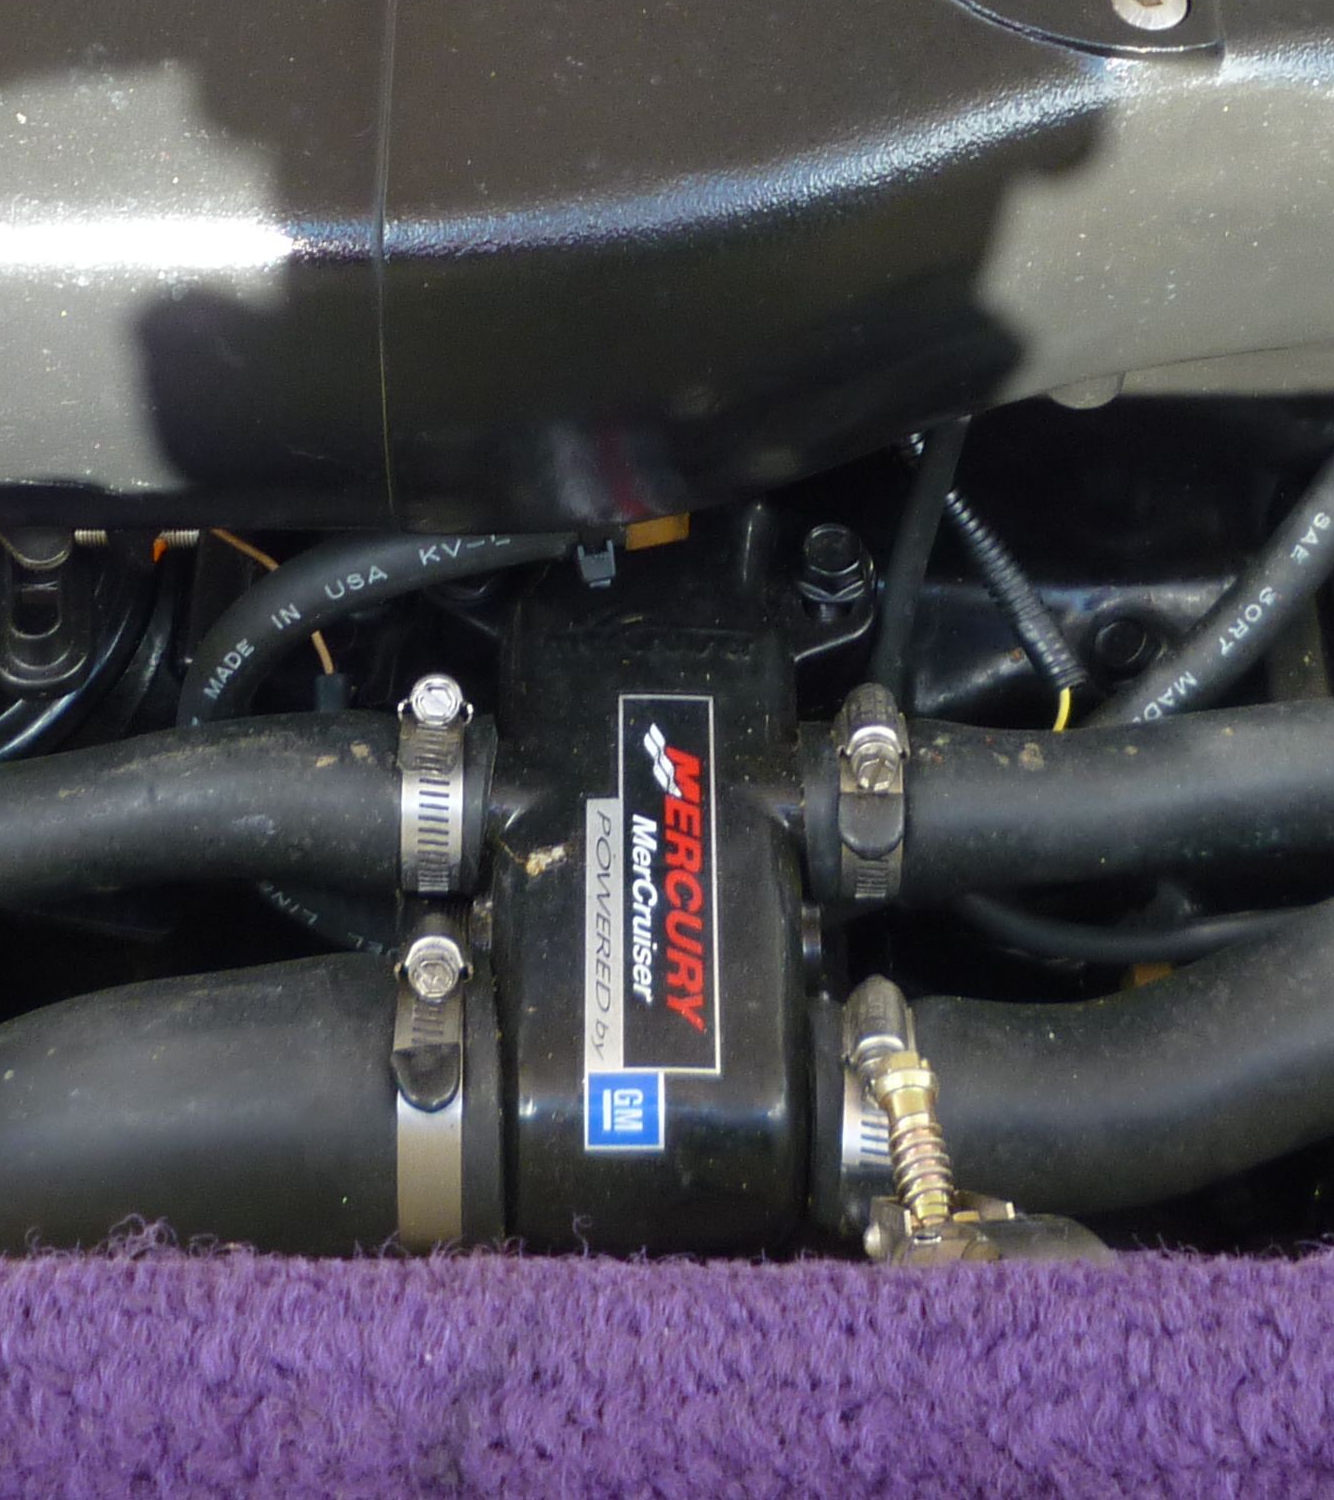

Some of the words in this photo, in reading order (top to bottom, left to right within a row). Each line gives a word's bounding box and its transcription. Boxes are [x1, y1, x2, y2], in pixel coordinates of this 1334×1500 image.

[1290, 510, 1332, 566] SAE
[203, 637, 256, 700] MADE
[270, 601, 302, 631] IN
[323, 564, 389, 601] USA
[1132, 670, 1199, 724] MAD
[595, 810, 613, 1014] POWERED
[631, 812, 659, 1004] MerCruiser
[663, 745, 707, 1034] MERCURY
[593, 1019, 610, 1060] by
[613, 1086, 644, 1133] GM
